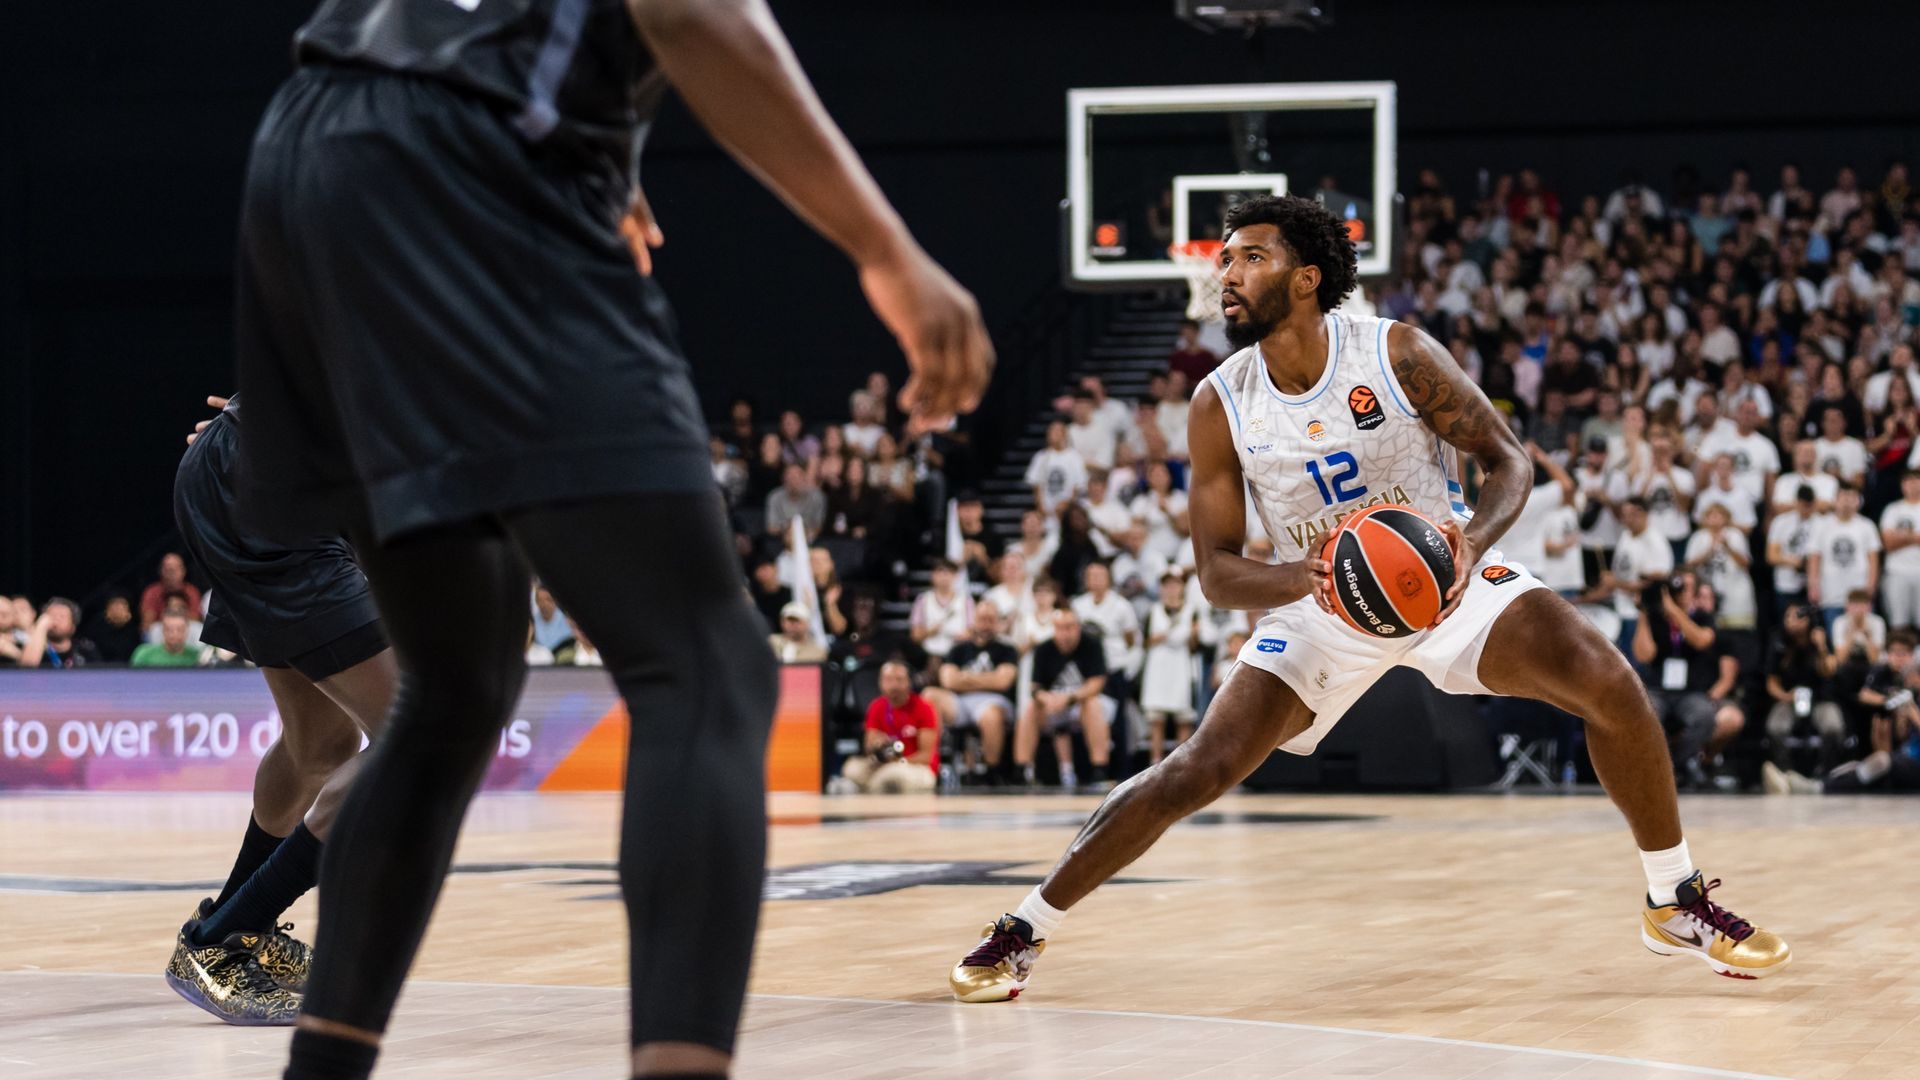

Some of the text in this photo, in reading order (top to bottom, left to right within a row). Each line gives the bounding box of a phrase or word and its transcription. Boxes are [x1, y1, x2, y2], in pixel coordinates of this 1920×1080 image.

[1305, 451, 1369, 506] 12
[1286, 484, 1412, 550] VAIA
[1343, 558, 1382, 626] EuroLeague
[1, 714, 49, 759] to
[58, 719, 158, 759] over
[166, 711, 240, 759] 120
